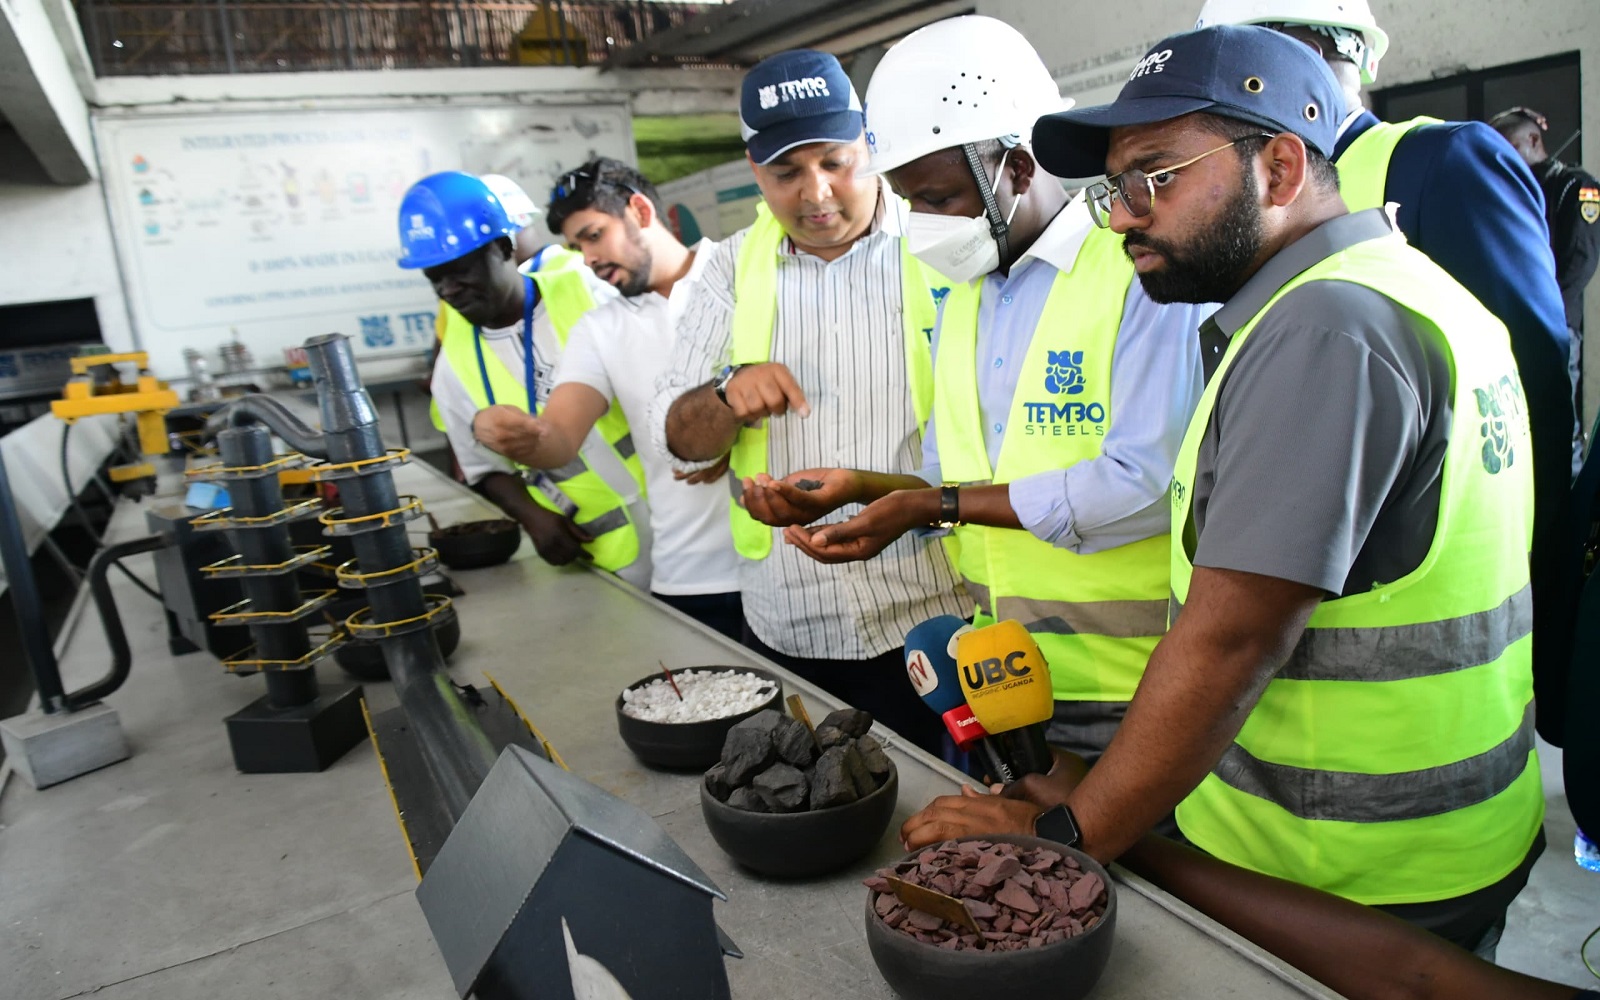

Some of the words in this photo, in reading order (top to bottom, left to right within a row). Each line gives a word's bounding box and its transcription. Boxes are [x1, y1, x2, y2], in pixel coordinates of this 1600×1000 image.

[1131, 49, 1173, 76] MBO
[778, 77, 827, 96] TEMBO
[1023, 402, 1105, 423] TEMBO
[1025, 424, 1104, 436] STEELS
[963, 651, 1031, 689] UBC
[1002, 677, 1034, 691] UGANDA
